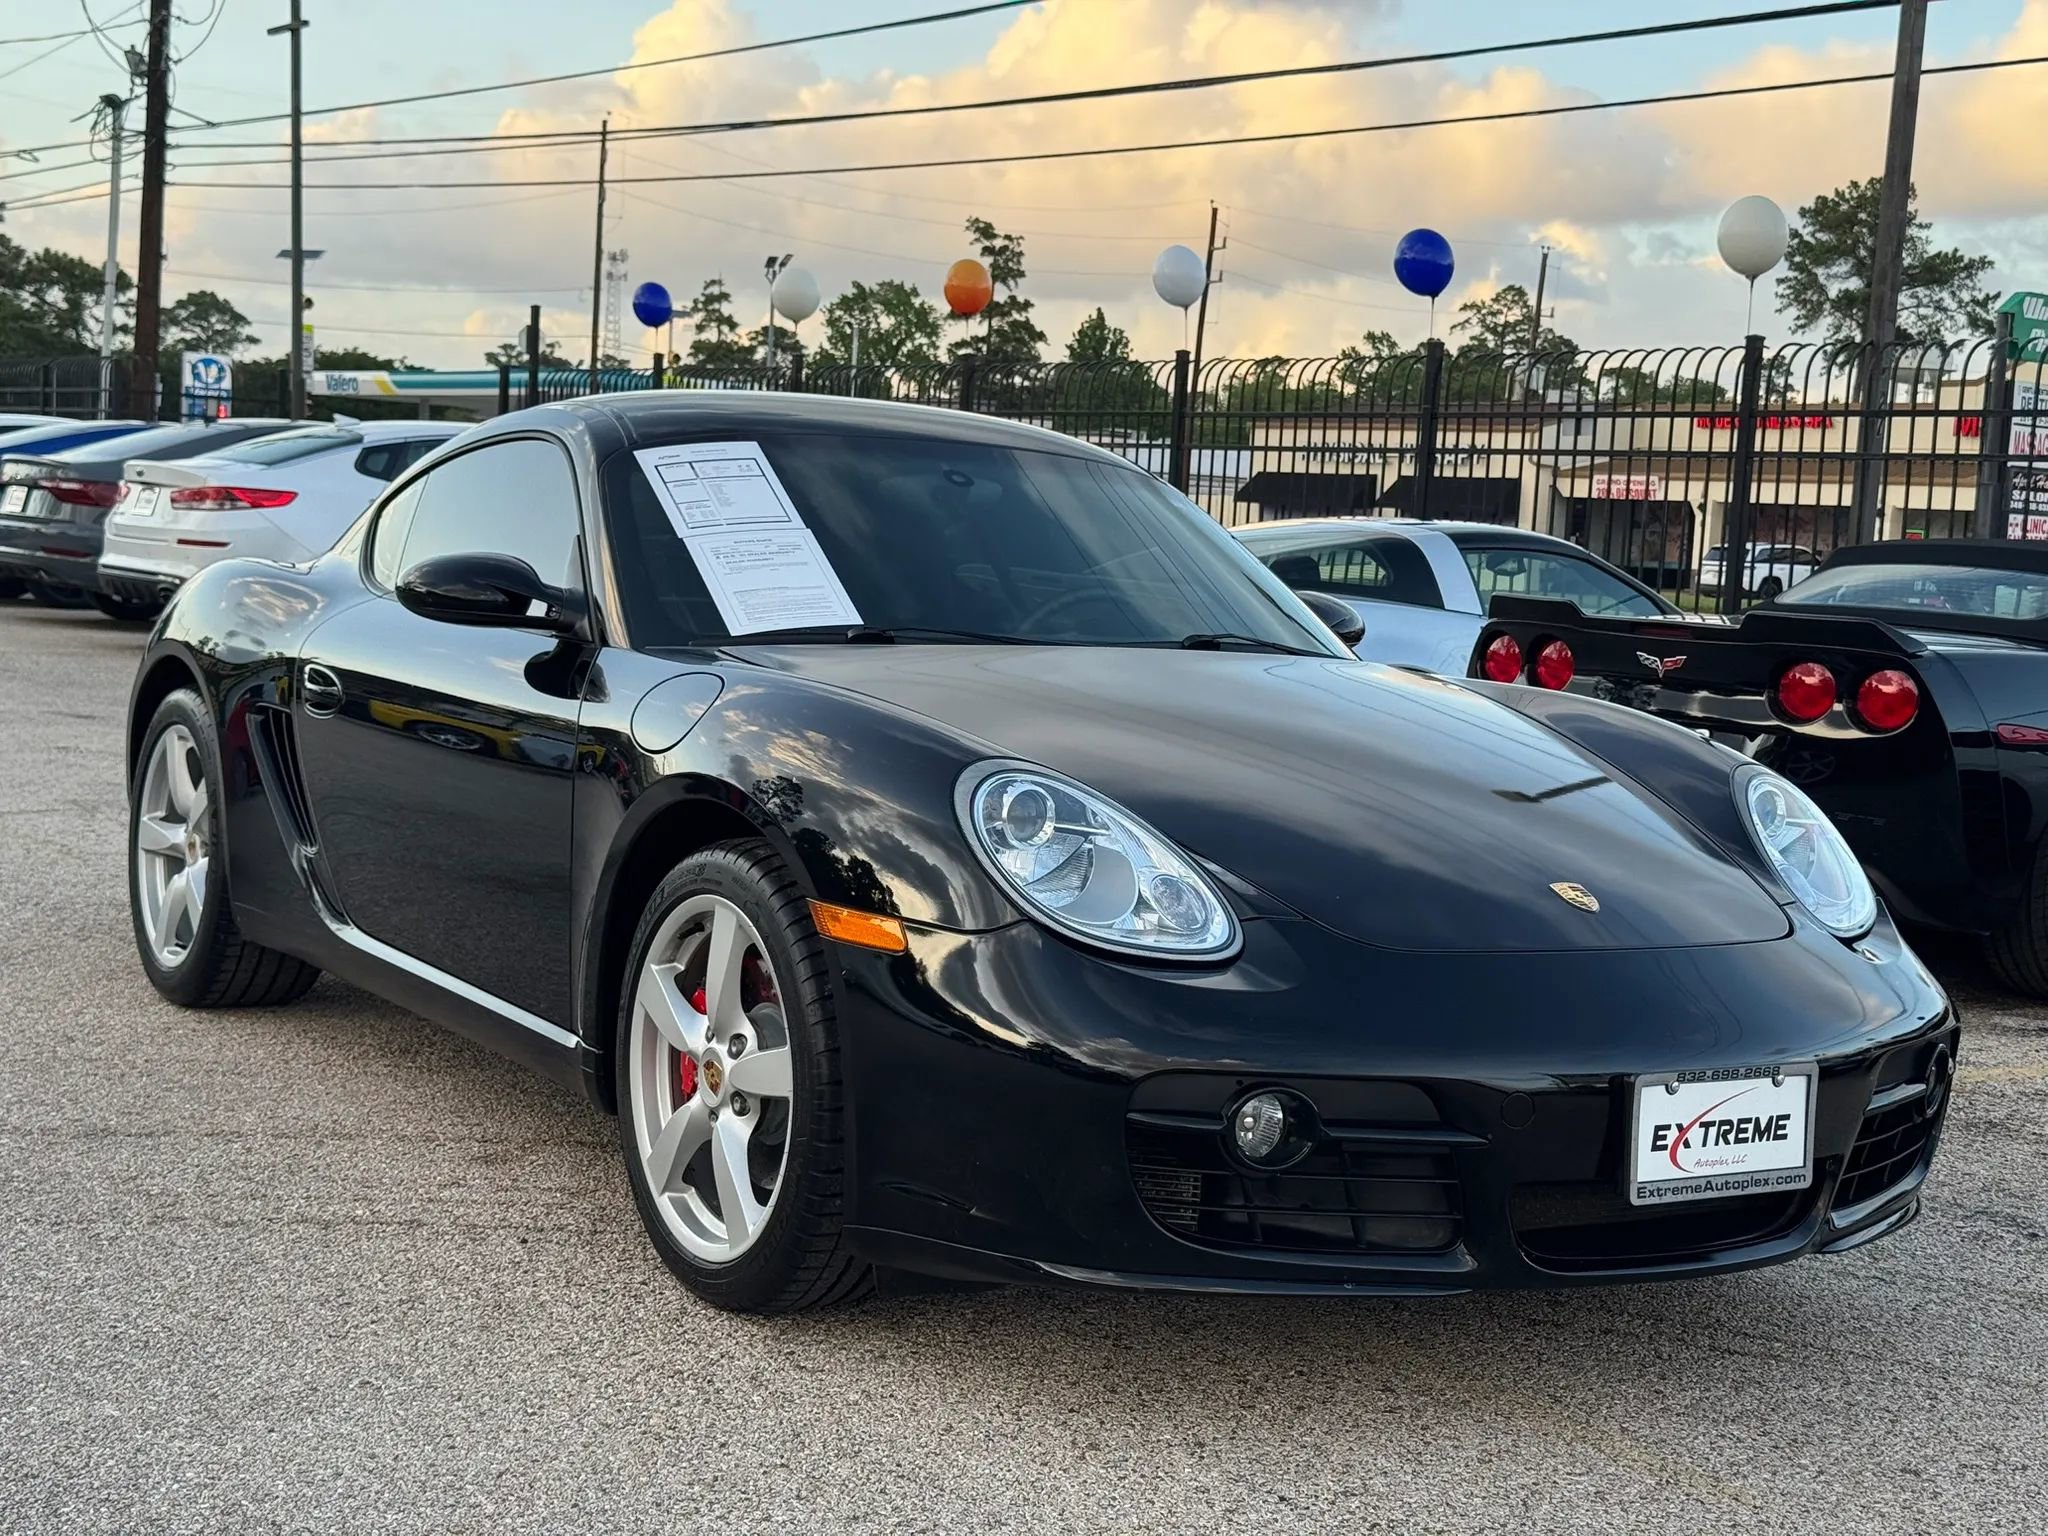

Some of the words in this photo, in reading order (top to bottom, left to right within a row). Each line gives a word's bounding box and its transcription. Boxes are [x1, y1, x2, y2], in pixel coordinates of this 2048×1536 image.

[1650, 1113, 1791, 1153] EXTREME
[1731, 1154, 1748, 1165] LLC
[1636, 1172, 1806, 1200] ExtremeAutoplex.com
